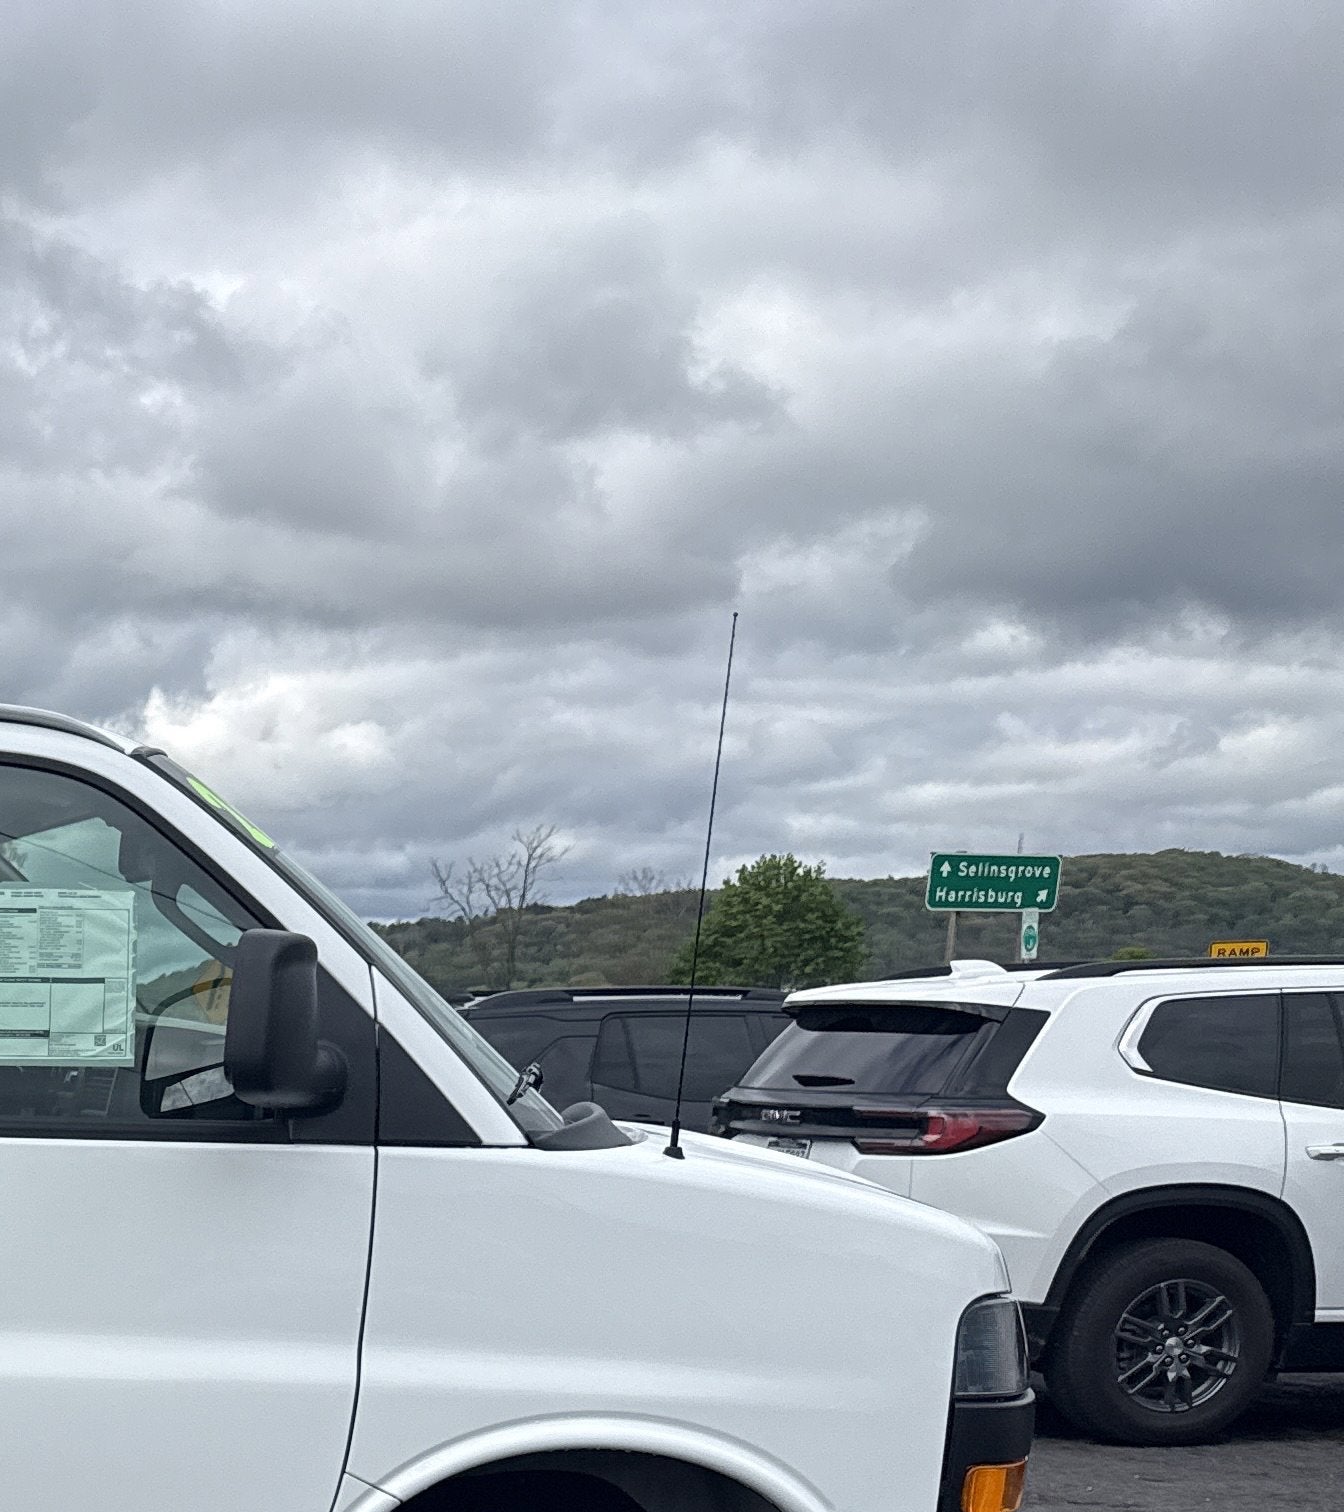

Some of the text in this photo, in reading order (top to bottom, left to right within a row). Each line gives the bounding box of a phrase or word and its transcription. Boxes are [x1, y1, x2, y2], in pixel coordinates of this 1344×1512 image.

[957, 861, 1051, 882] Selinsgrove
[935, 886, 1023, 907] Harrisburg
[1216, 946, 1261, 958] RAMP
